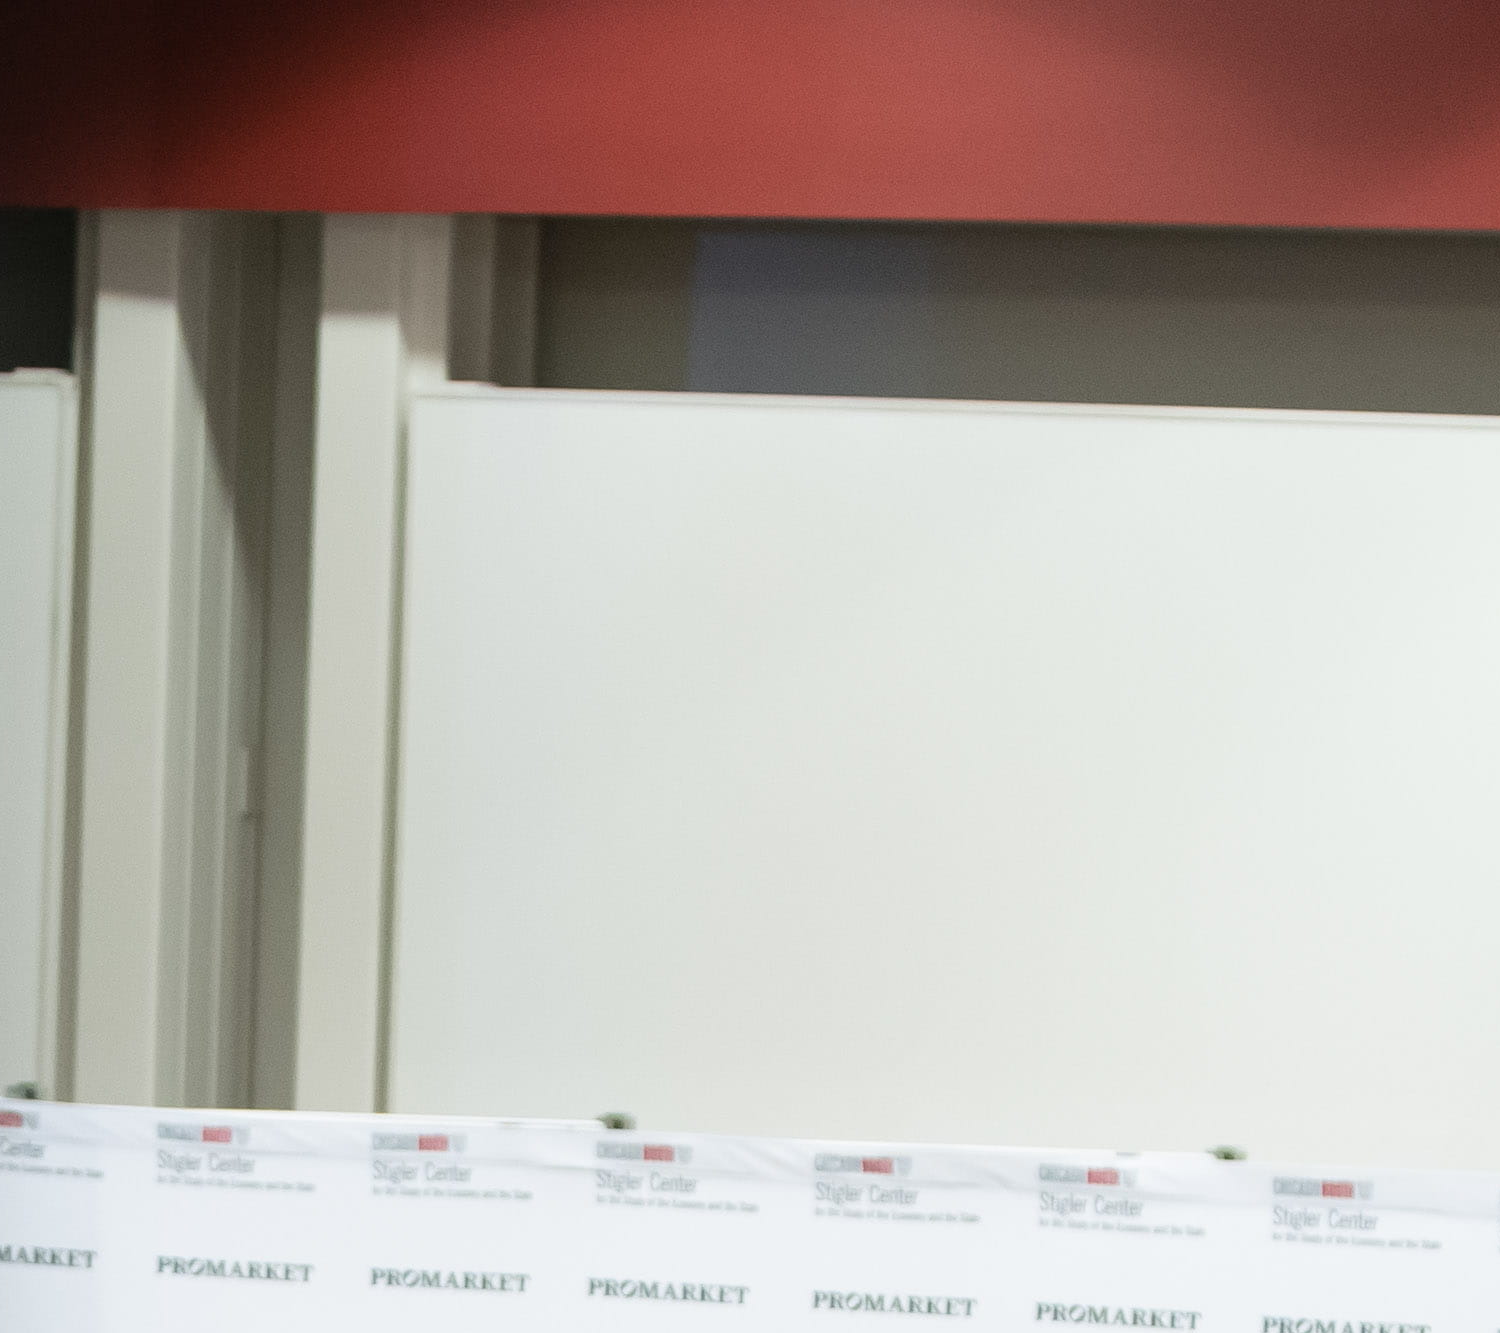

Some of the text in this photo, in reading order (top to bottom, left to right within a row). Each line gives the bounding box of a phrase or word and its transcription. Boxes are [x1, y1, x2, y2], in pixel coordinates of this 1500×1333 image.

[154, 1255, 313, 1284] PROMARKET
[368, 1267, 529, 1293] PROMARKET
[586, 1277, 749, 1306] PROMARKET
[810, 1290, 976, 1318] PROMARKET
[1033, 1302, 1200, 1331] PROMARKET
